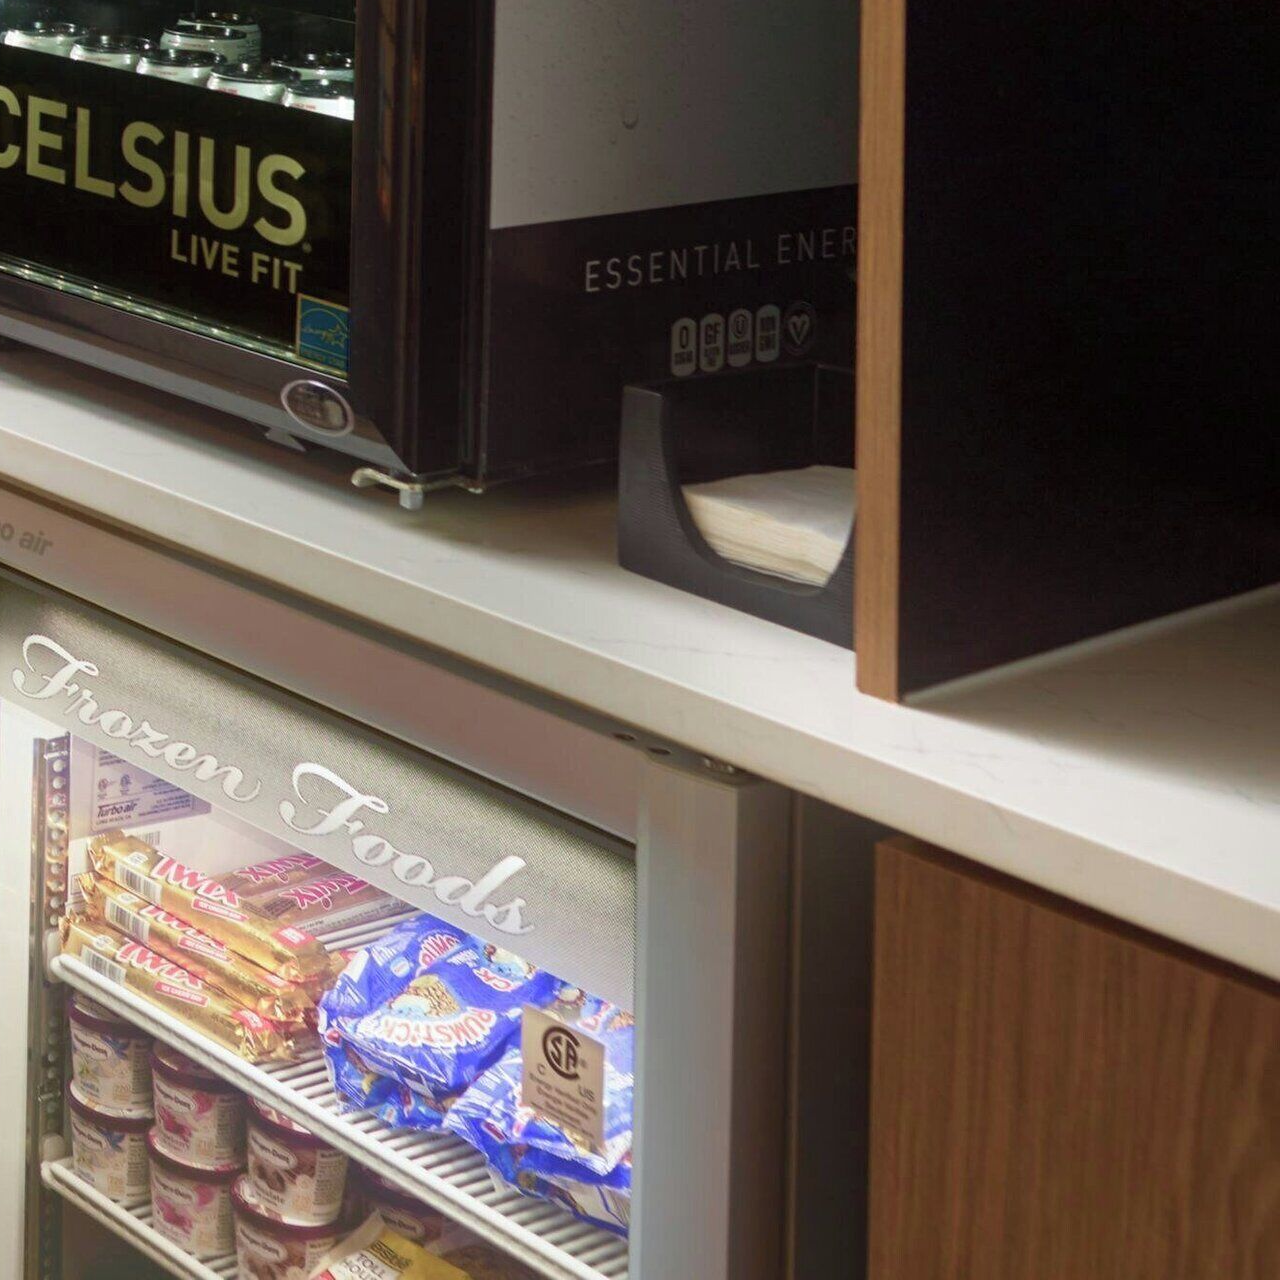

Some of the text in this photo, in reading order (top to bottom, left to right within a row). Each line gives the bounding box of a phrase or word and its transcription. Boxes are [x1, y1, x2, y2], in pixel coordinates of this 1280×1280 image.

[171, 229, 303, 294] LIVE FIT
[584, 226, 856, 293] ESSENTIAL ENER
[19, 530, 54, 558] air
[11, 633, 536, 938] Frozen Foods
[151, 855, 241, 909] TWIX
[116, 938, 203, 990] TWIX
